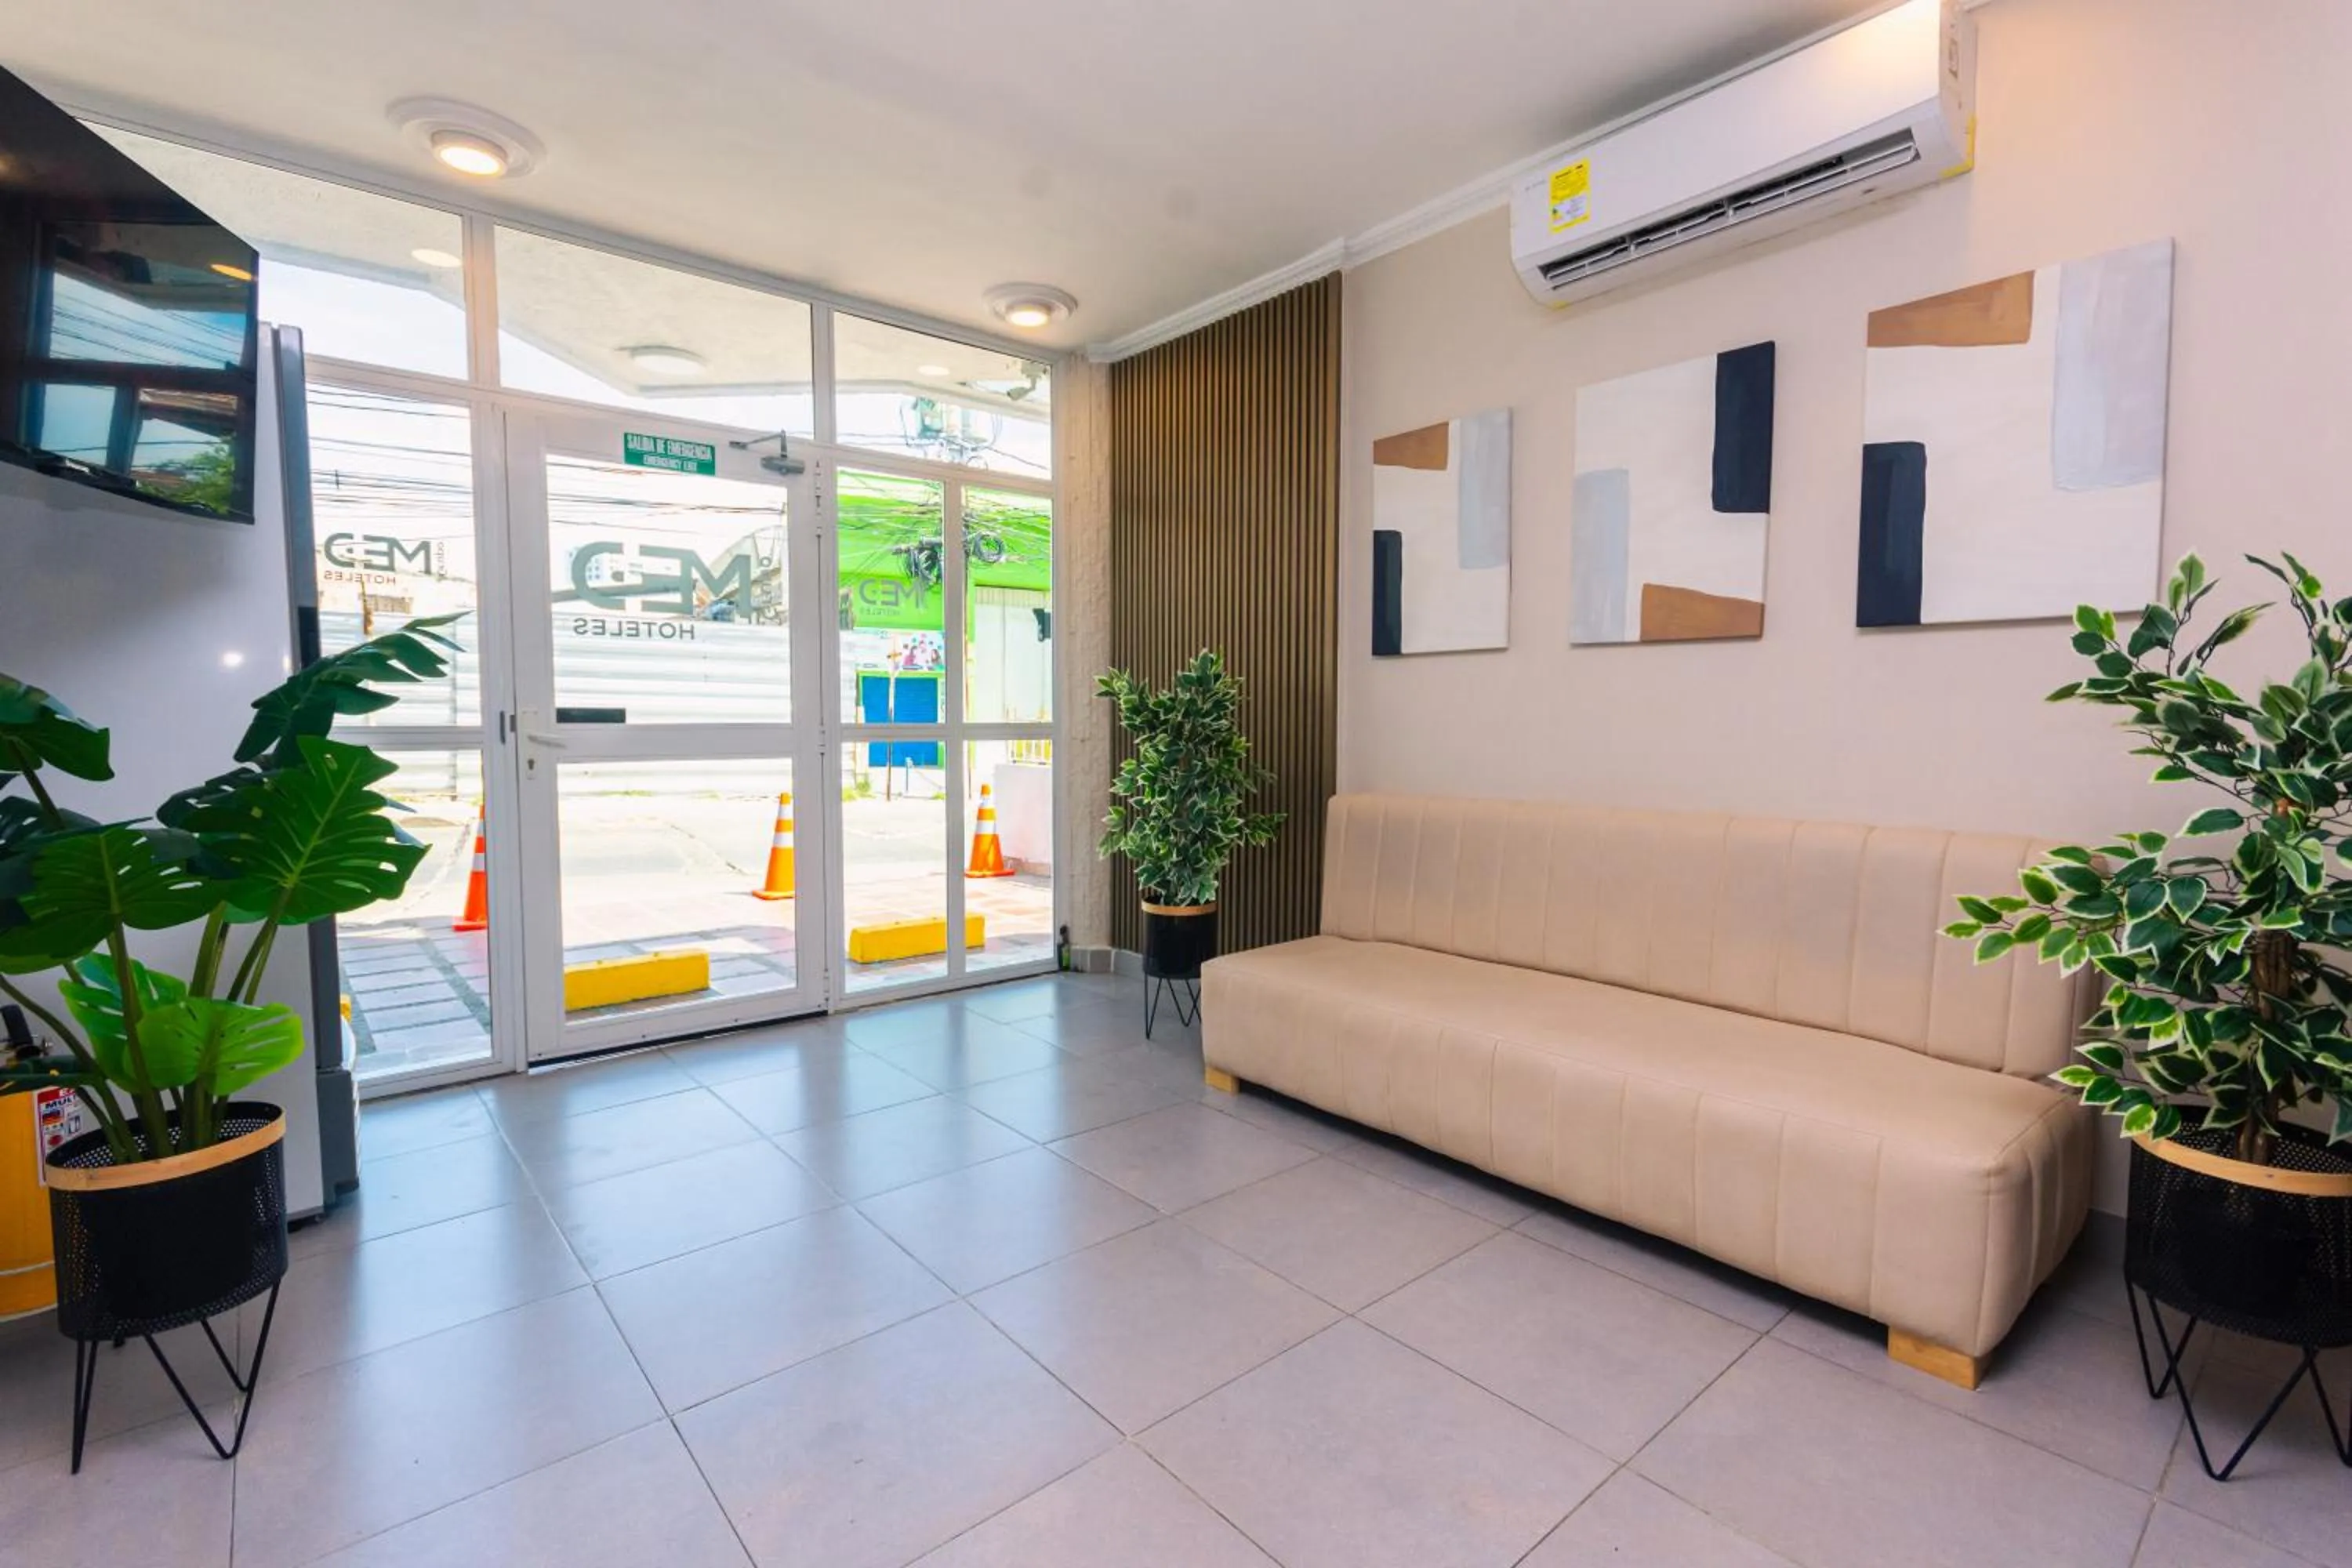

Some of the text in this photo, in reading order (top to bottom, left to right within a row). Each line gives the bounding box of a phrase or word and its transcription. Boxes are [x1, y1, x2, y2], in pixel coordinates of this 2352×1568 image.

[627, 434, 711, 459] SALIDA DE EMERGENCIA
